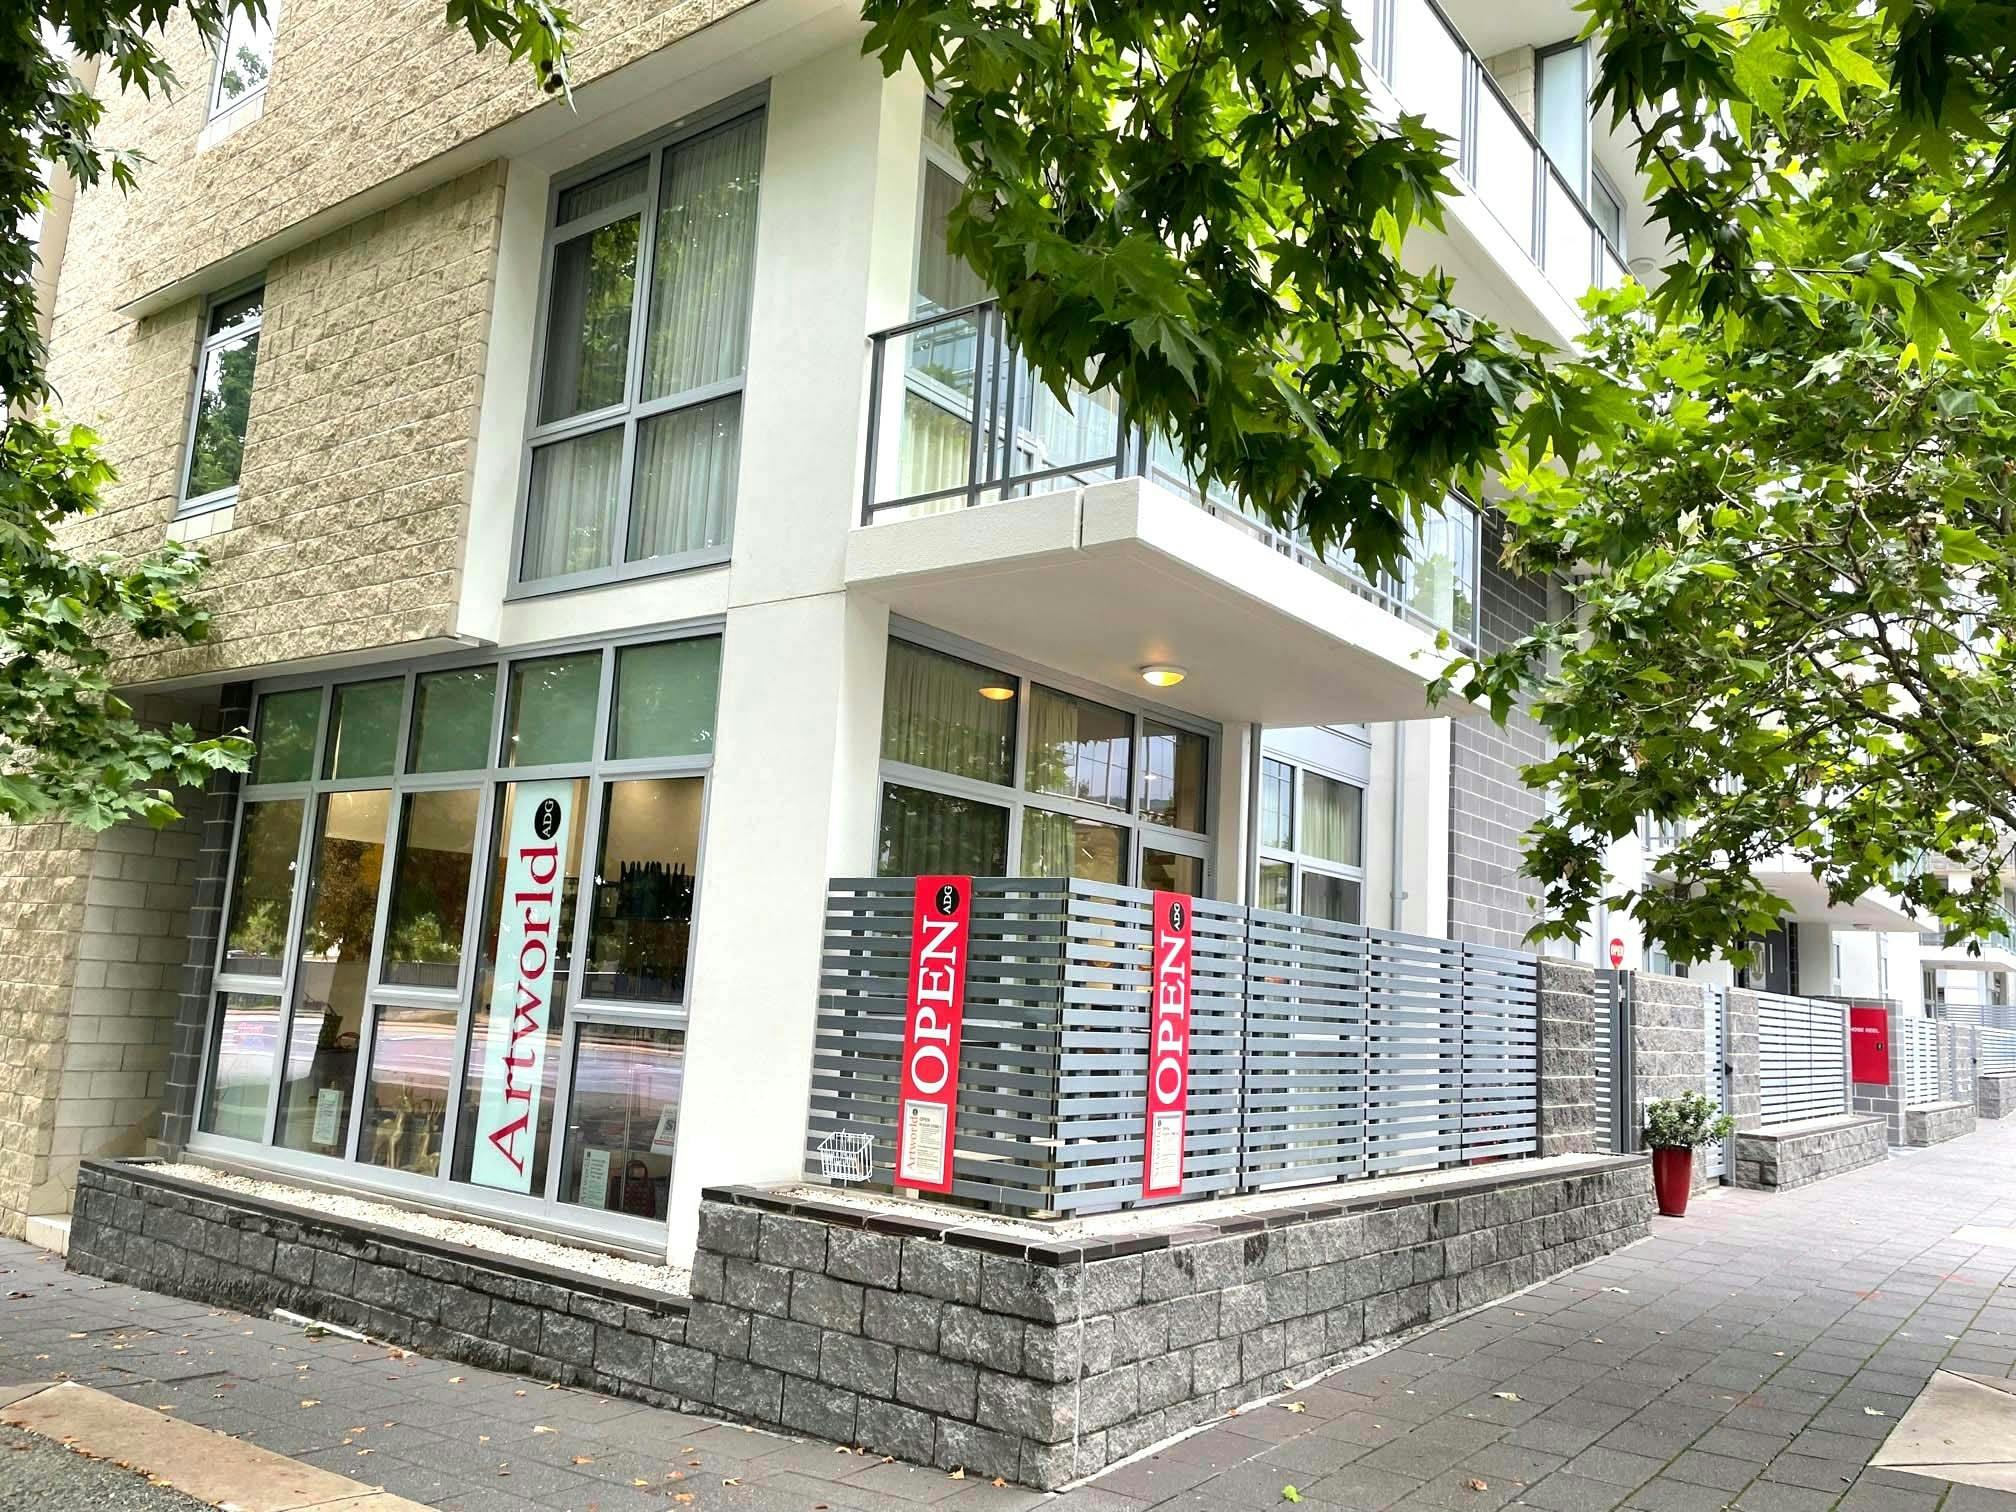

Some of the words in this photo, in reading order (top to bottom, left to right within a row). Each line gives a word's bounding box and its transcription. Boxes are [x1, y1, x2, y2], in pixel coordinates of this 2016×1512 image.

[534, 799, 556, 839] ADG
[942, 885, 953, 914] ADG
[488, 842, 561, 1177] Artworld
[910, 914, 960, 1095] OPEN
[1154, 929, 1186, 1105] OPEN
